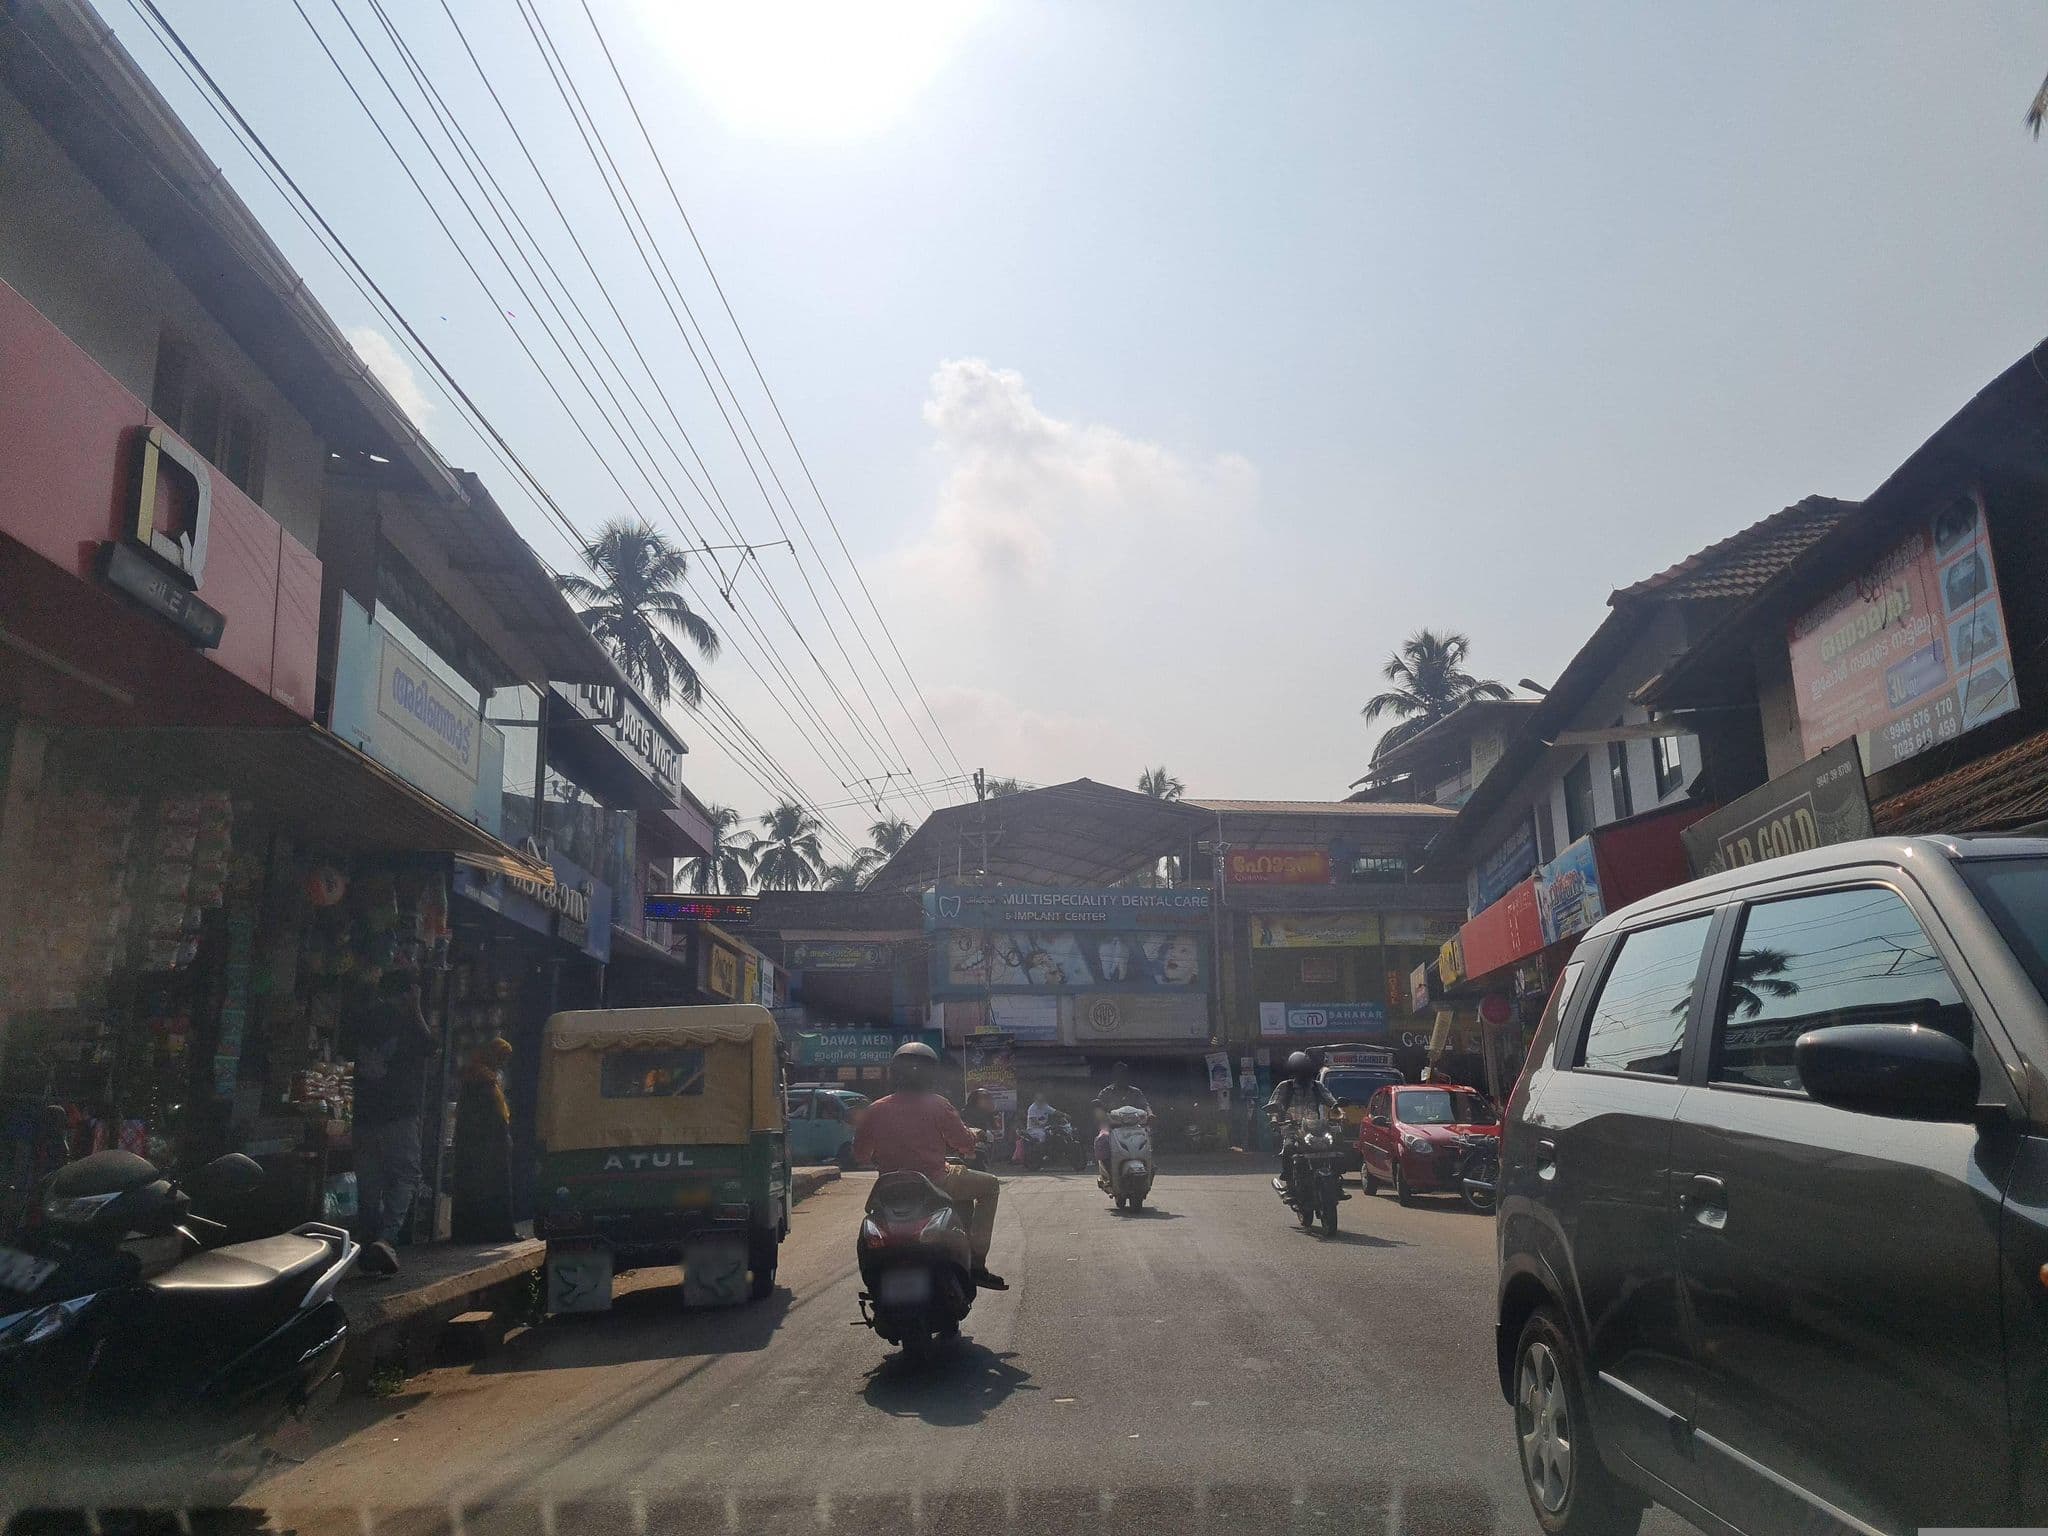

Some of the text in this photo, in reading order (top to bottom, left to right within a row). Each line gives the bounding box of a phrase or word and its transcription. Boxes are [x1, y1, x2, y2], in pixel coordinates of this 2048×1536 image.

[616, 708, 650, 757] ports
[652, 730, 678, 785] World
[1757, 807, 1818, 862] GOLD
[1004, 893, 1117, 907] MULTISPECIALITY
[1121, 895, 1174, 908] DENTAL
[1175, 896, 1209, 908] CARE
[1014, 911, 1062, 921] IMPLANT
[1064, 912, 1107, 922] CENTER
[820, 1035, 858, 1047] DAWA
[604, 1151, 695, 1170] ATUL
